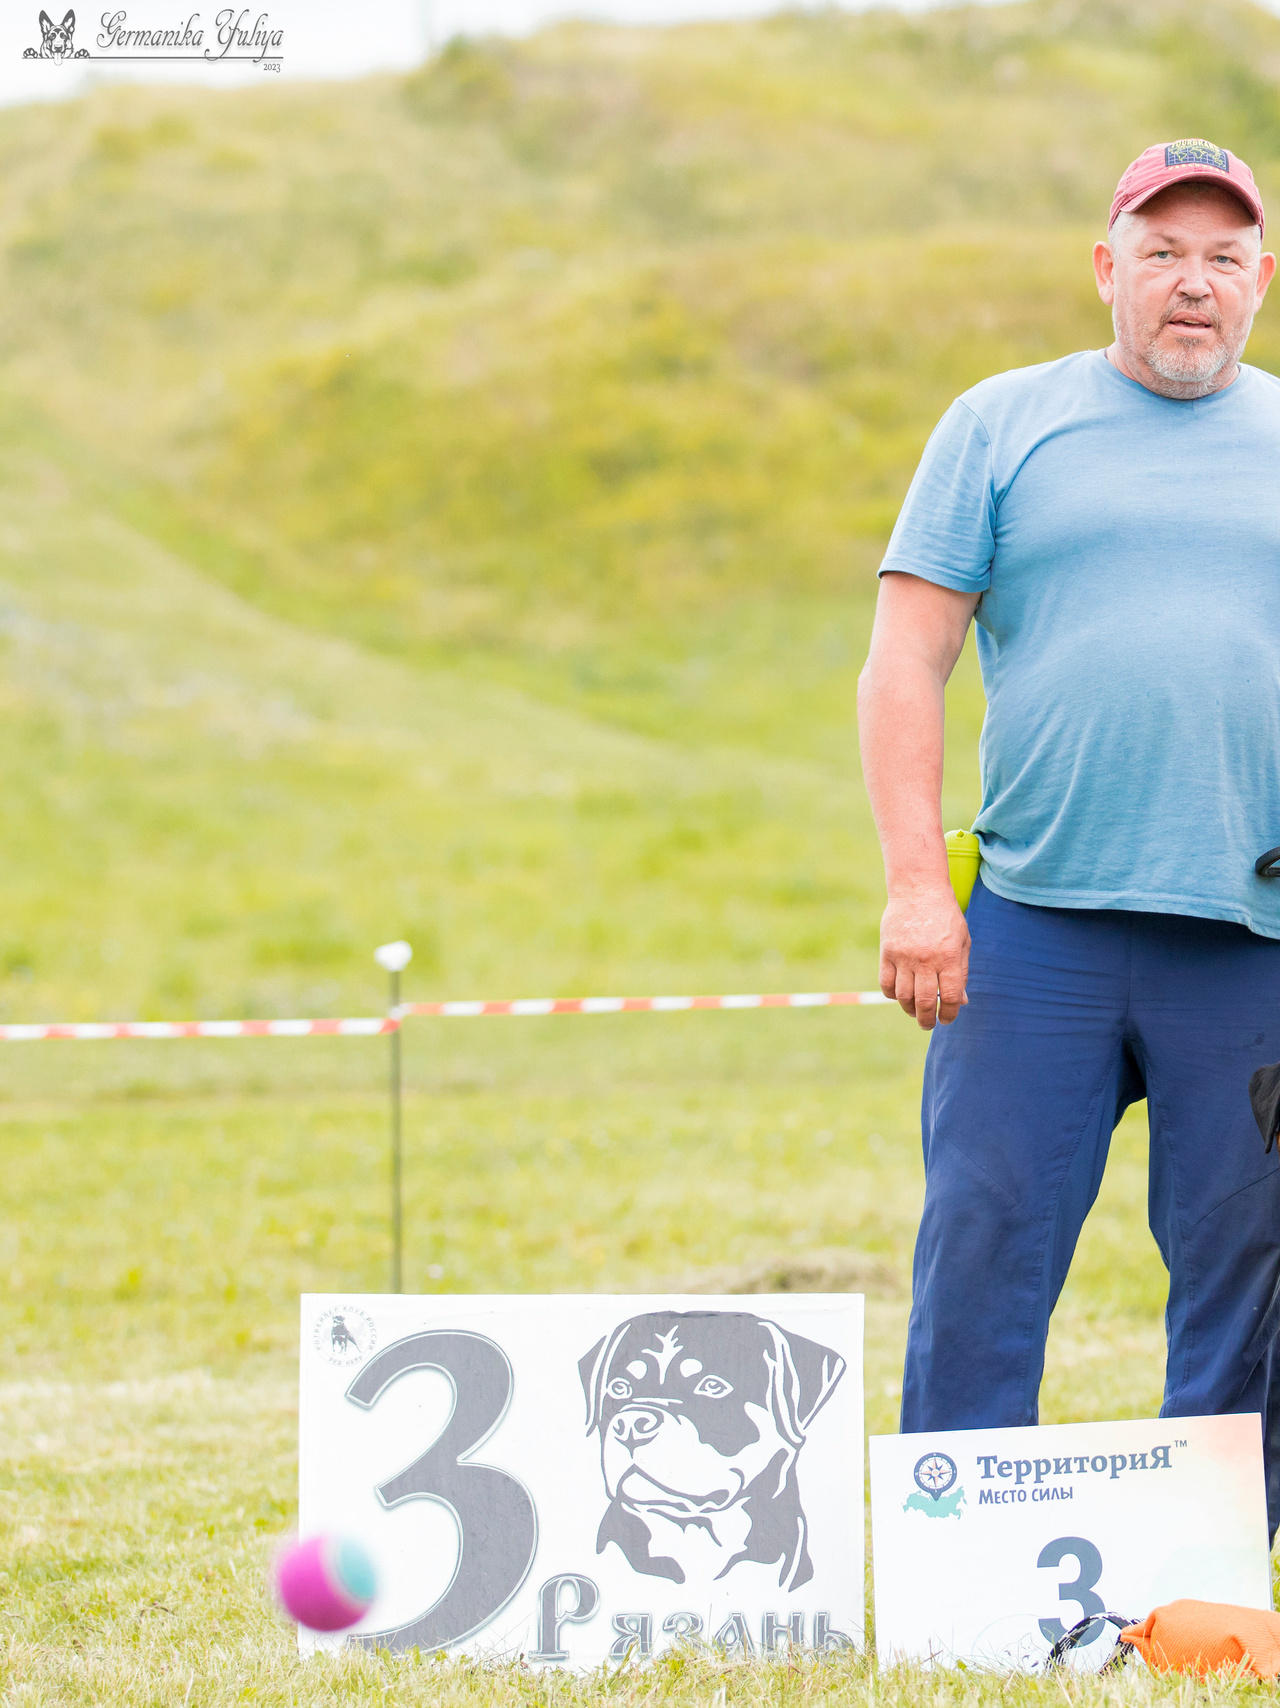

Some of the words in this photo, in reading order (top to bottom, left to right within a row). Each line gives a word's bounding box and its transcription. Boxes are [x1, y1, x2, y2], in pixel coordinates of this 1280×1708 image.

[344, 1328, 539, 1658] 3
[976, 1445, 1173, 1485] ТерриториЯ
[1036, 1536, 1108, 1649] 3
